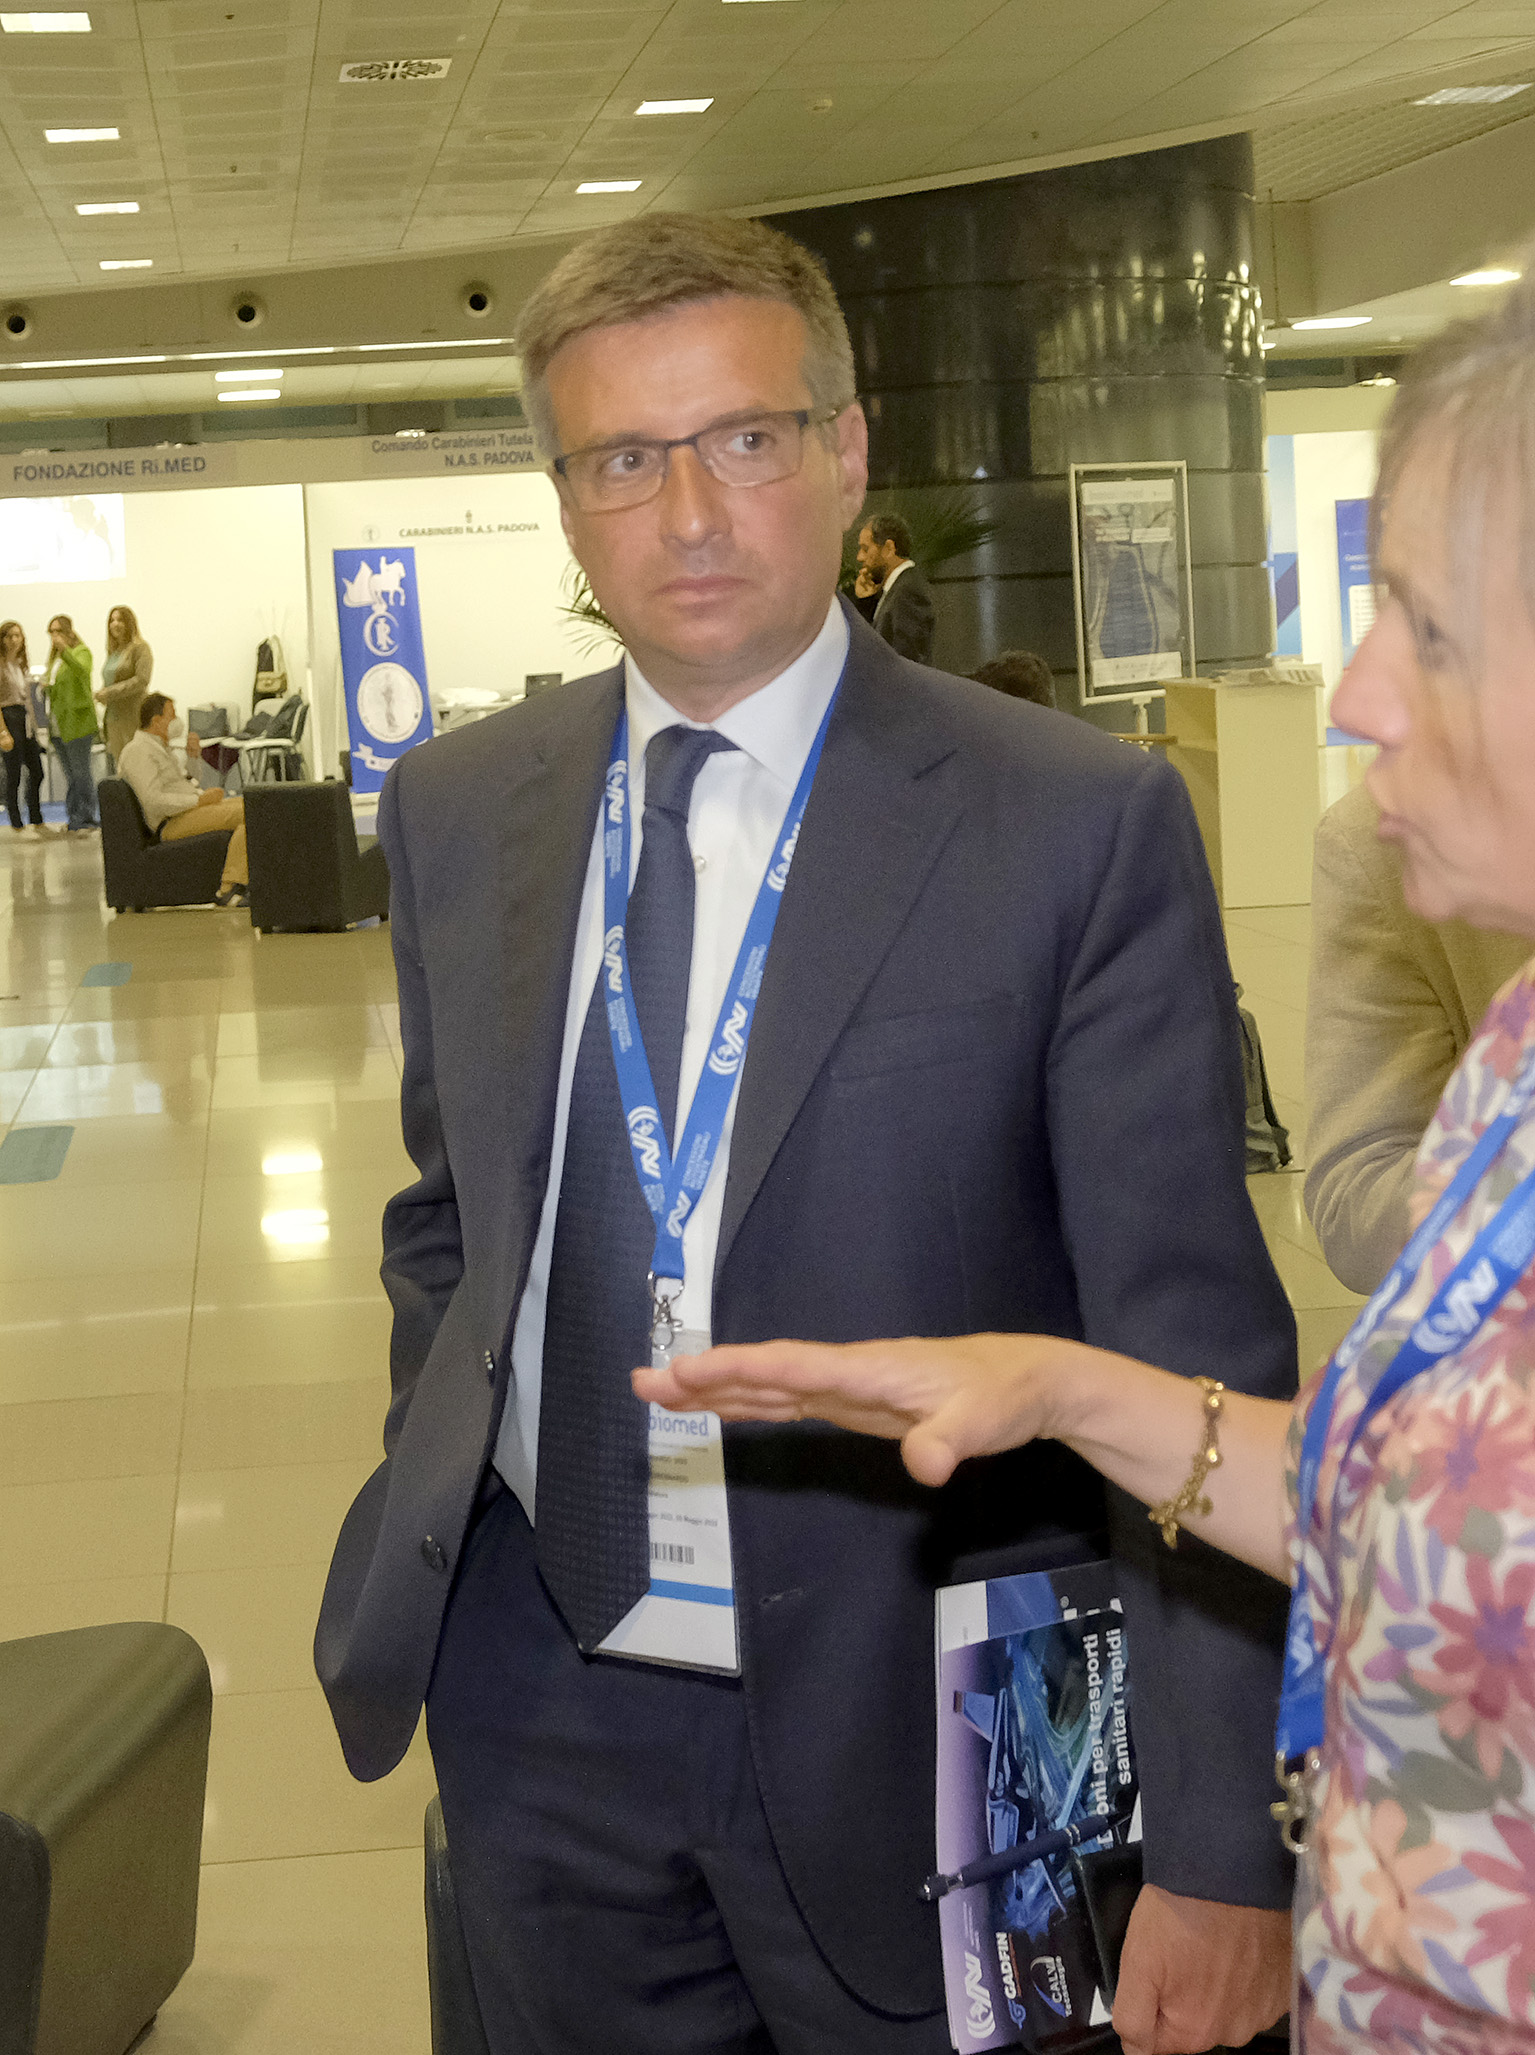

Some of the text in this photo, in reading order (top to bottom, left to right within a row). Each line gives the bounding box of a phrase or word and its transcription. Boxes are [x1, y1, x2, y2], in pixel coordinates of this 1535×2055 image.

[372, 434, 533, 454] Comando Carabinieri Tutela
[484, 451, 534, 465] PADOVA
[13, 457, 206, 481] FONDAZIONE Ri.MED
[399, 526, 464, 538] CARABINIERI
[498, 523, 540, 533] PADOVA
[1083, 1633, 1103, 1733] trasporti
[1106, 1628, 1132, 1786] sanitari rapidi
[1091, 1739, 1109, 1774] per
[996, 1932, 1016, 1999] GADFIN
